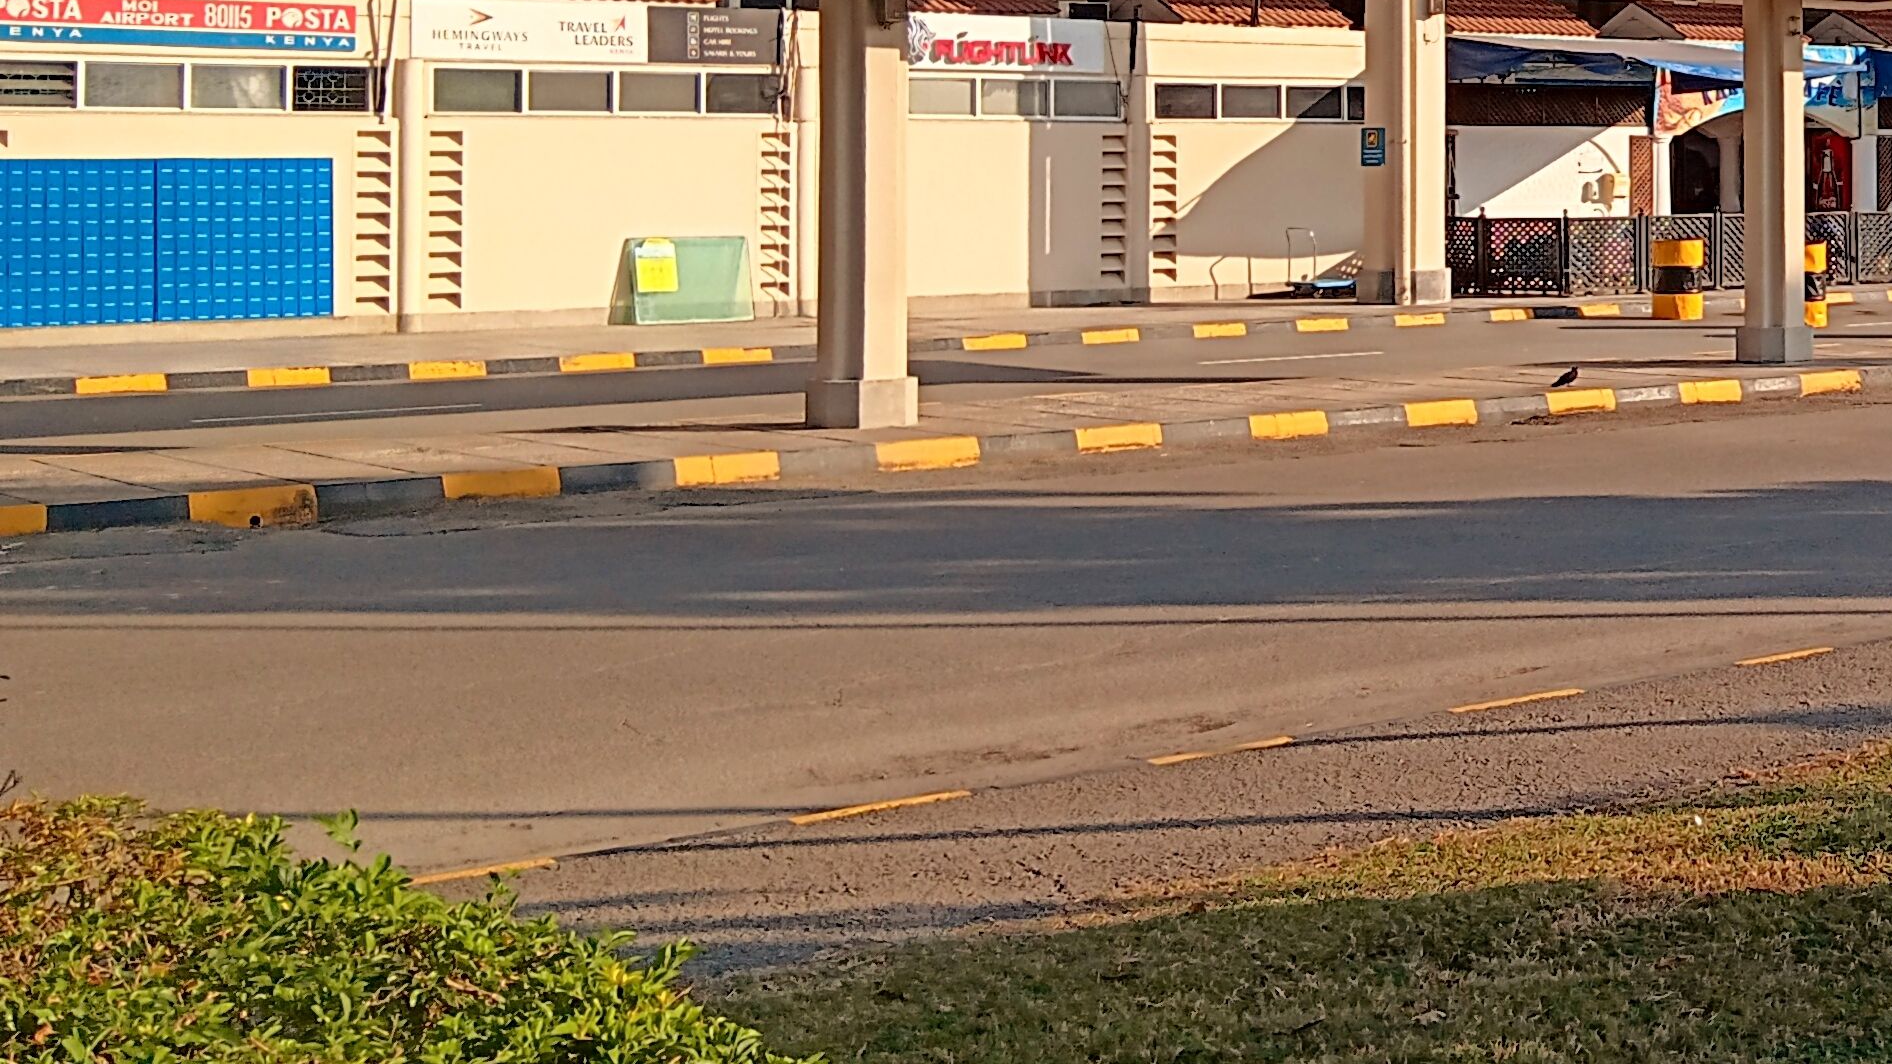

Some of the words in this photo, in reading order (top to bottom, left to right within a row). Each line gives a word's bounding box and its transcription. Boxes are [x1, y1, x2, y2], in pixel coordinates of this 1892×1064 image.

[121, 0, 158, 12] MOI
[100, 11, 194, 26] AIRPORT
[204, 3, 252, 28] 80115
[266, 6, 350, 30] POSTA
[559, 21, 607, 33] TRAVEL
[265, 35, 350, 47] KENYA
[432, 29, 528, 41] HEMINGWAYS
[574, 34, 633, 47] LEADERS
